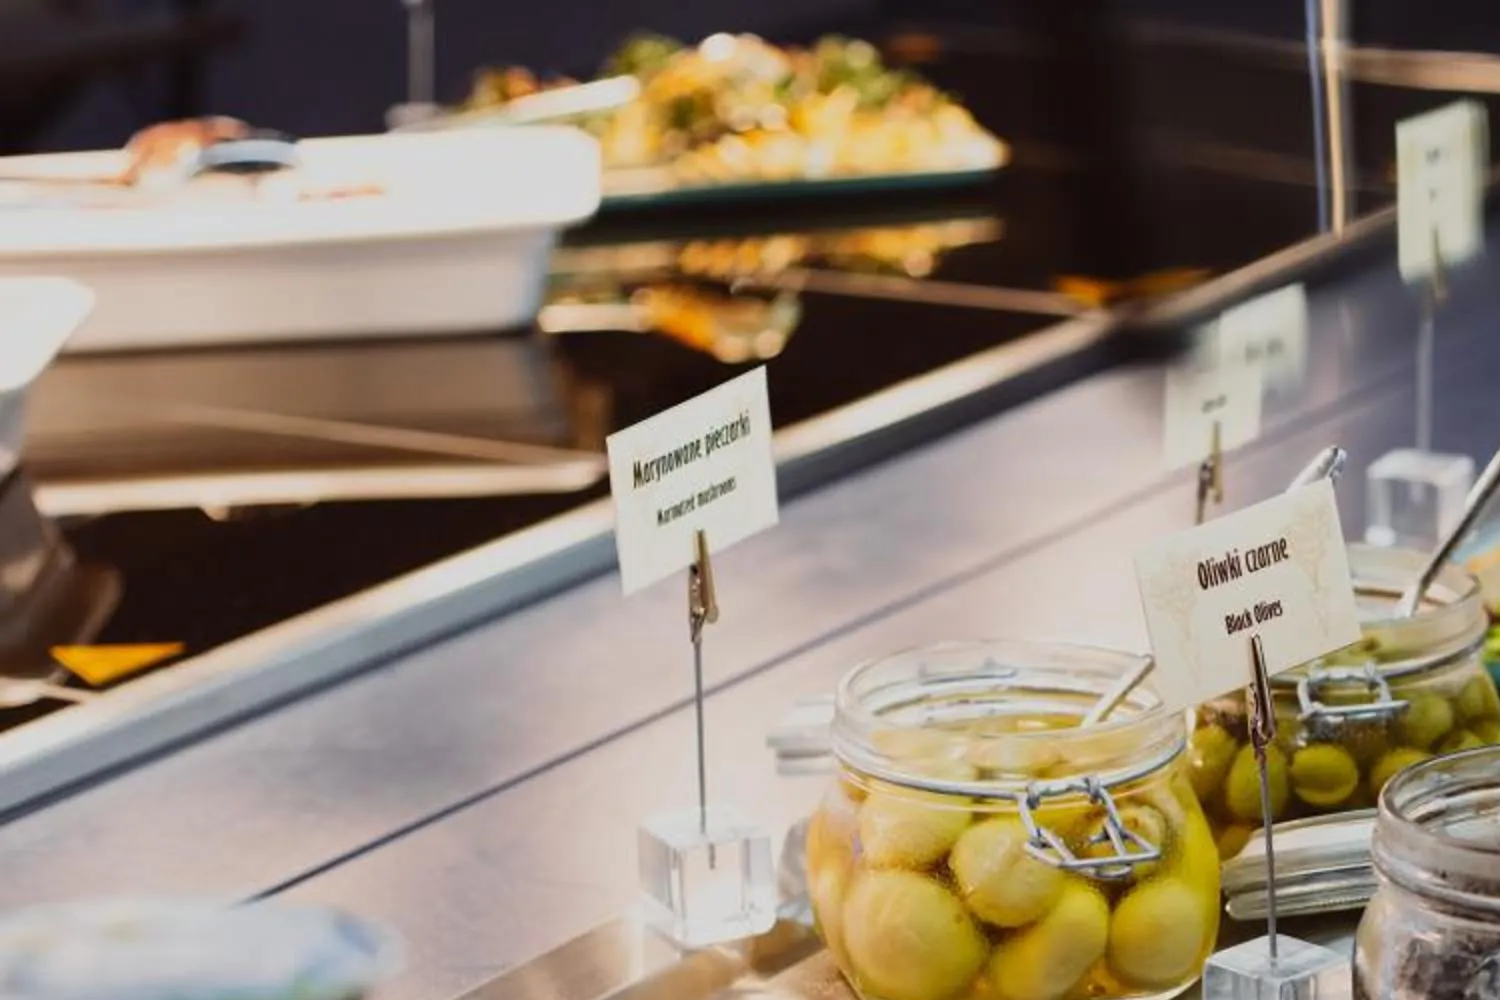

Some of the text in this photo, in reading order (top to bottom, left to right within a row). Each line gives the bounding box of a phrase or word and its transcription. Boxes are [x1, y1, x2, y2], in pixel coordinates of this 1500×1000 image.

[632, 409, 751, 489] Marynowane pieczarki
[1197, 537, 1290, 591] Oliwki czarne
[1225, 599, 1284, 635] Black Olives
